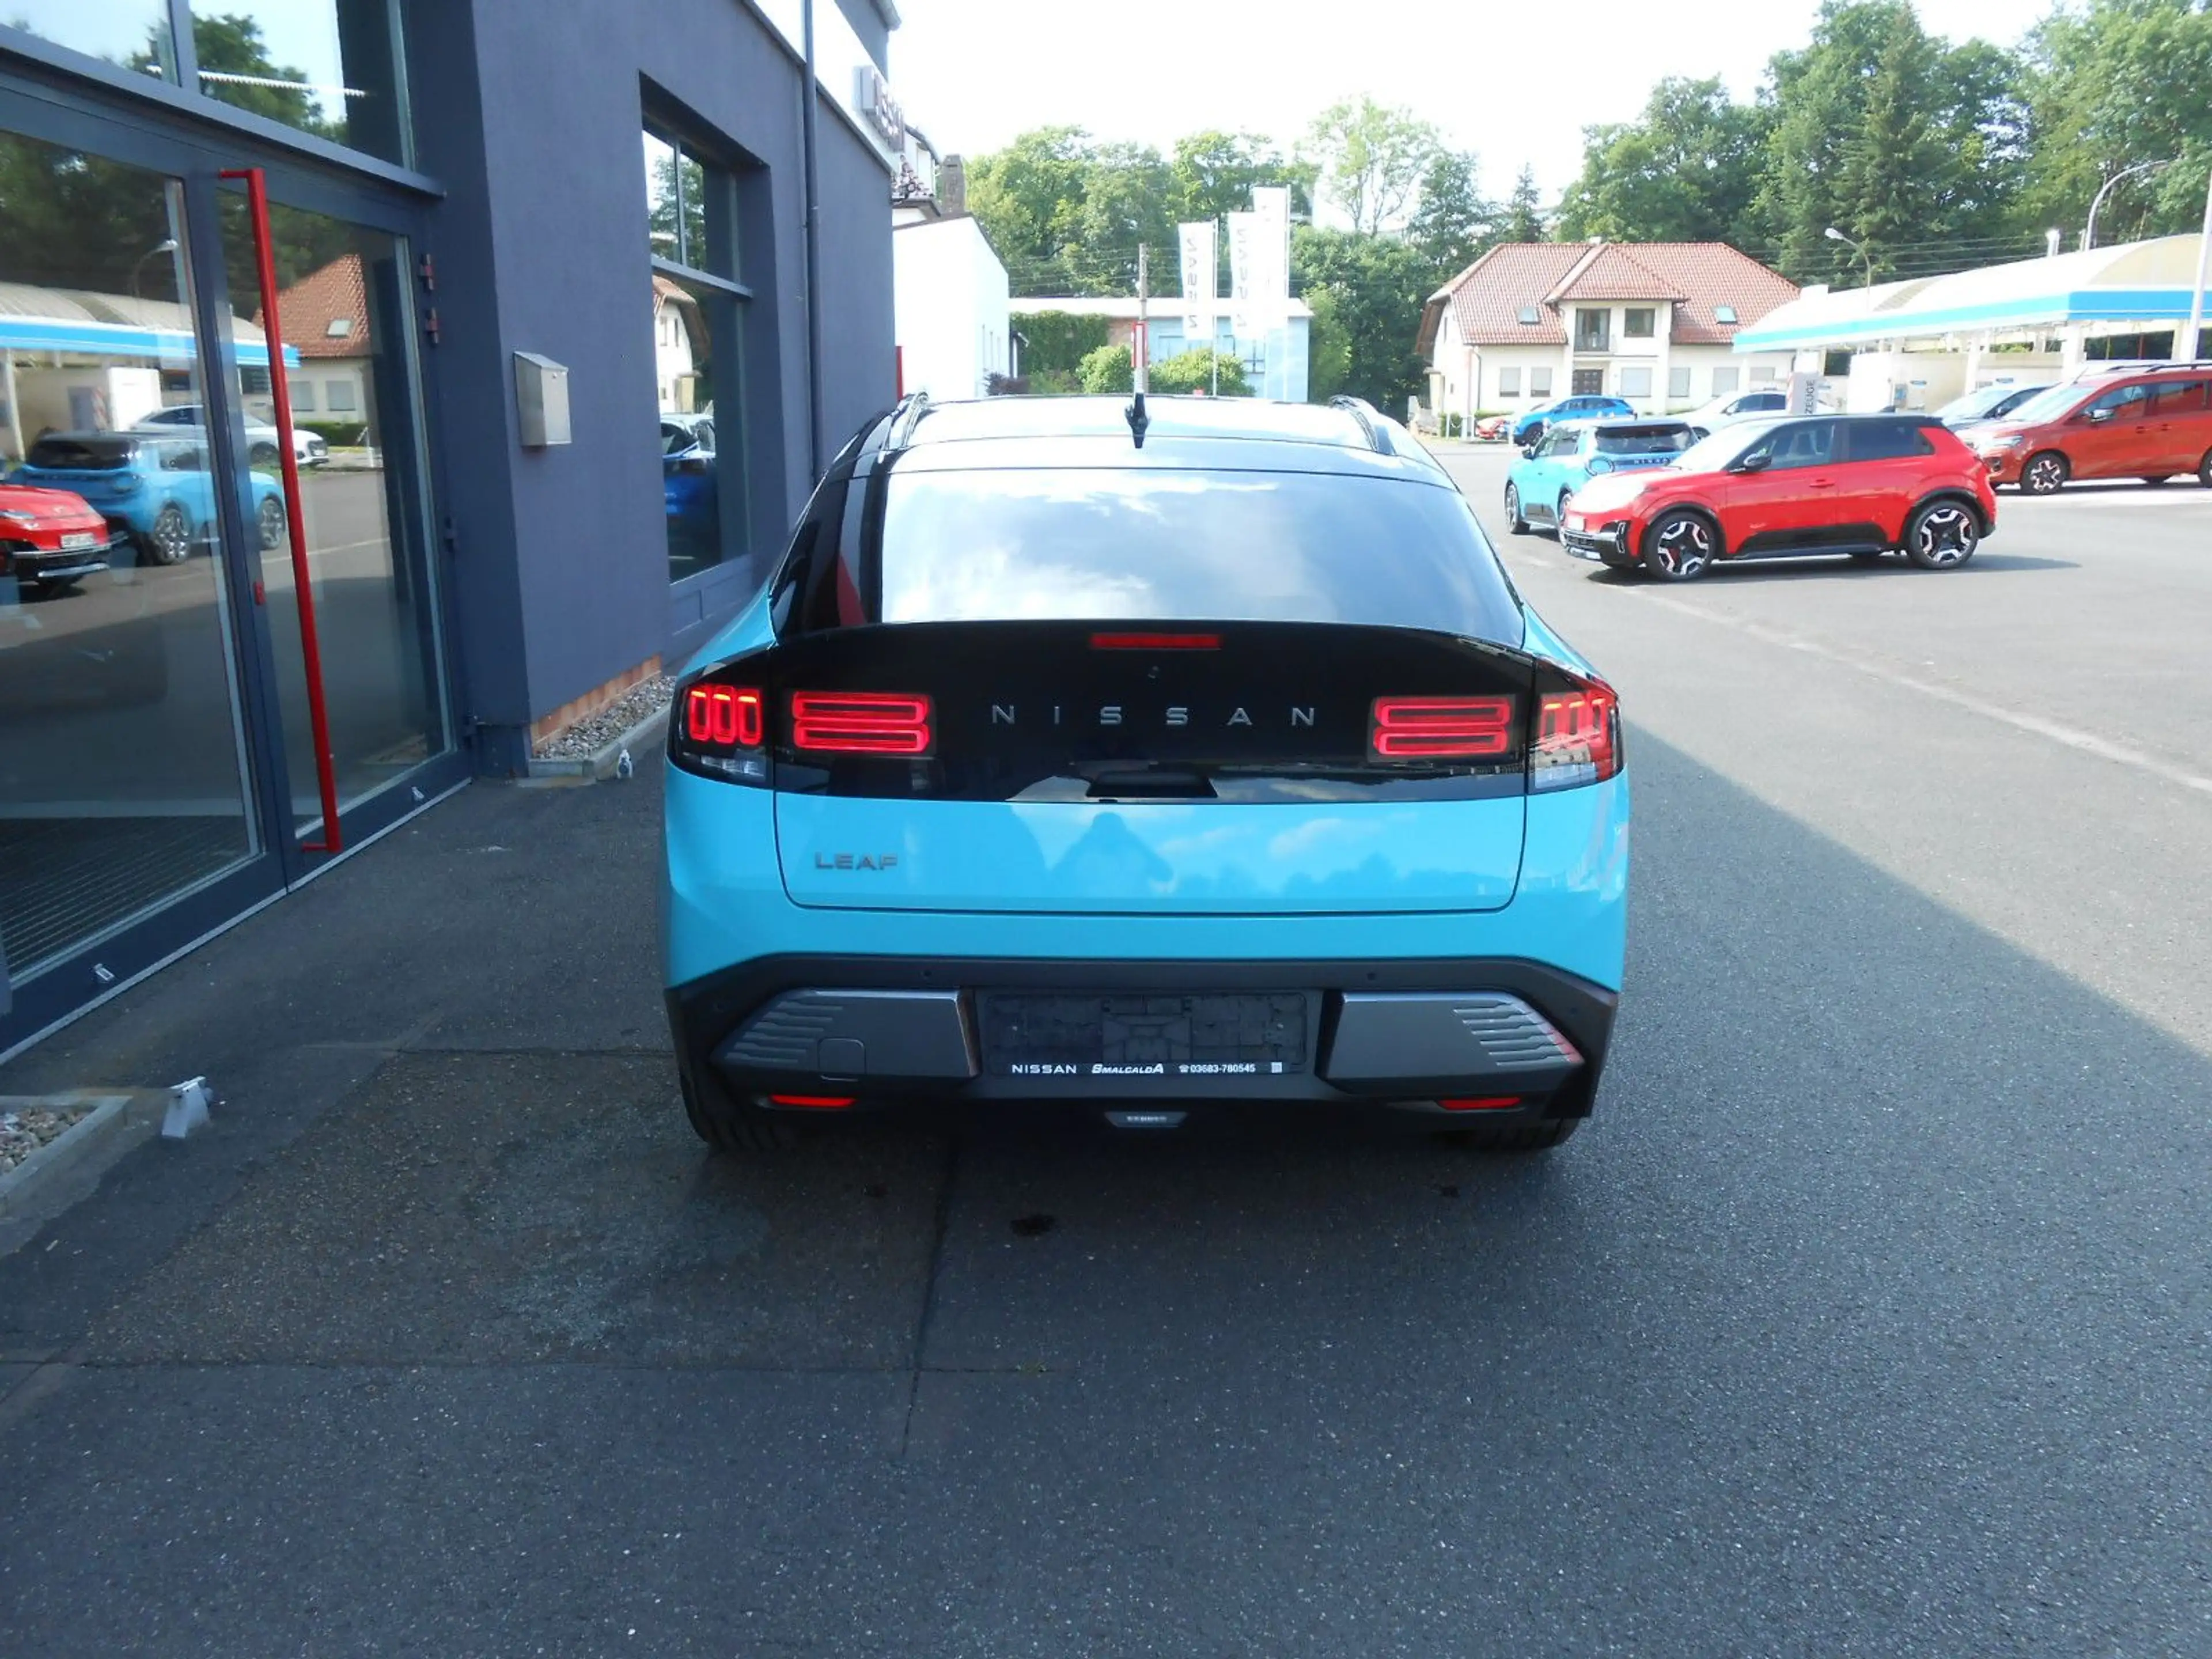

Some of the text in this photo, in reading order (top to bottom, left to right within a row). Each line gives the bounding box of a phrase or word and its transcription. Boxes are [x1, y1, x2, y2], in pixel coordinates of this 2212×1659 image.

[992, 704, 1315, 726] NISSAN
[815, 851, 897, 870] LEAF
[1012, 1064, 1077, 1074] NISSAN
